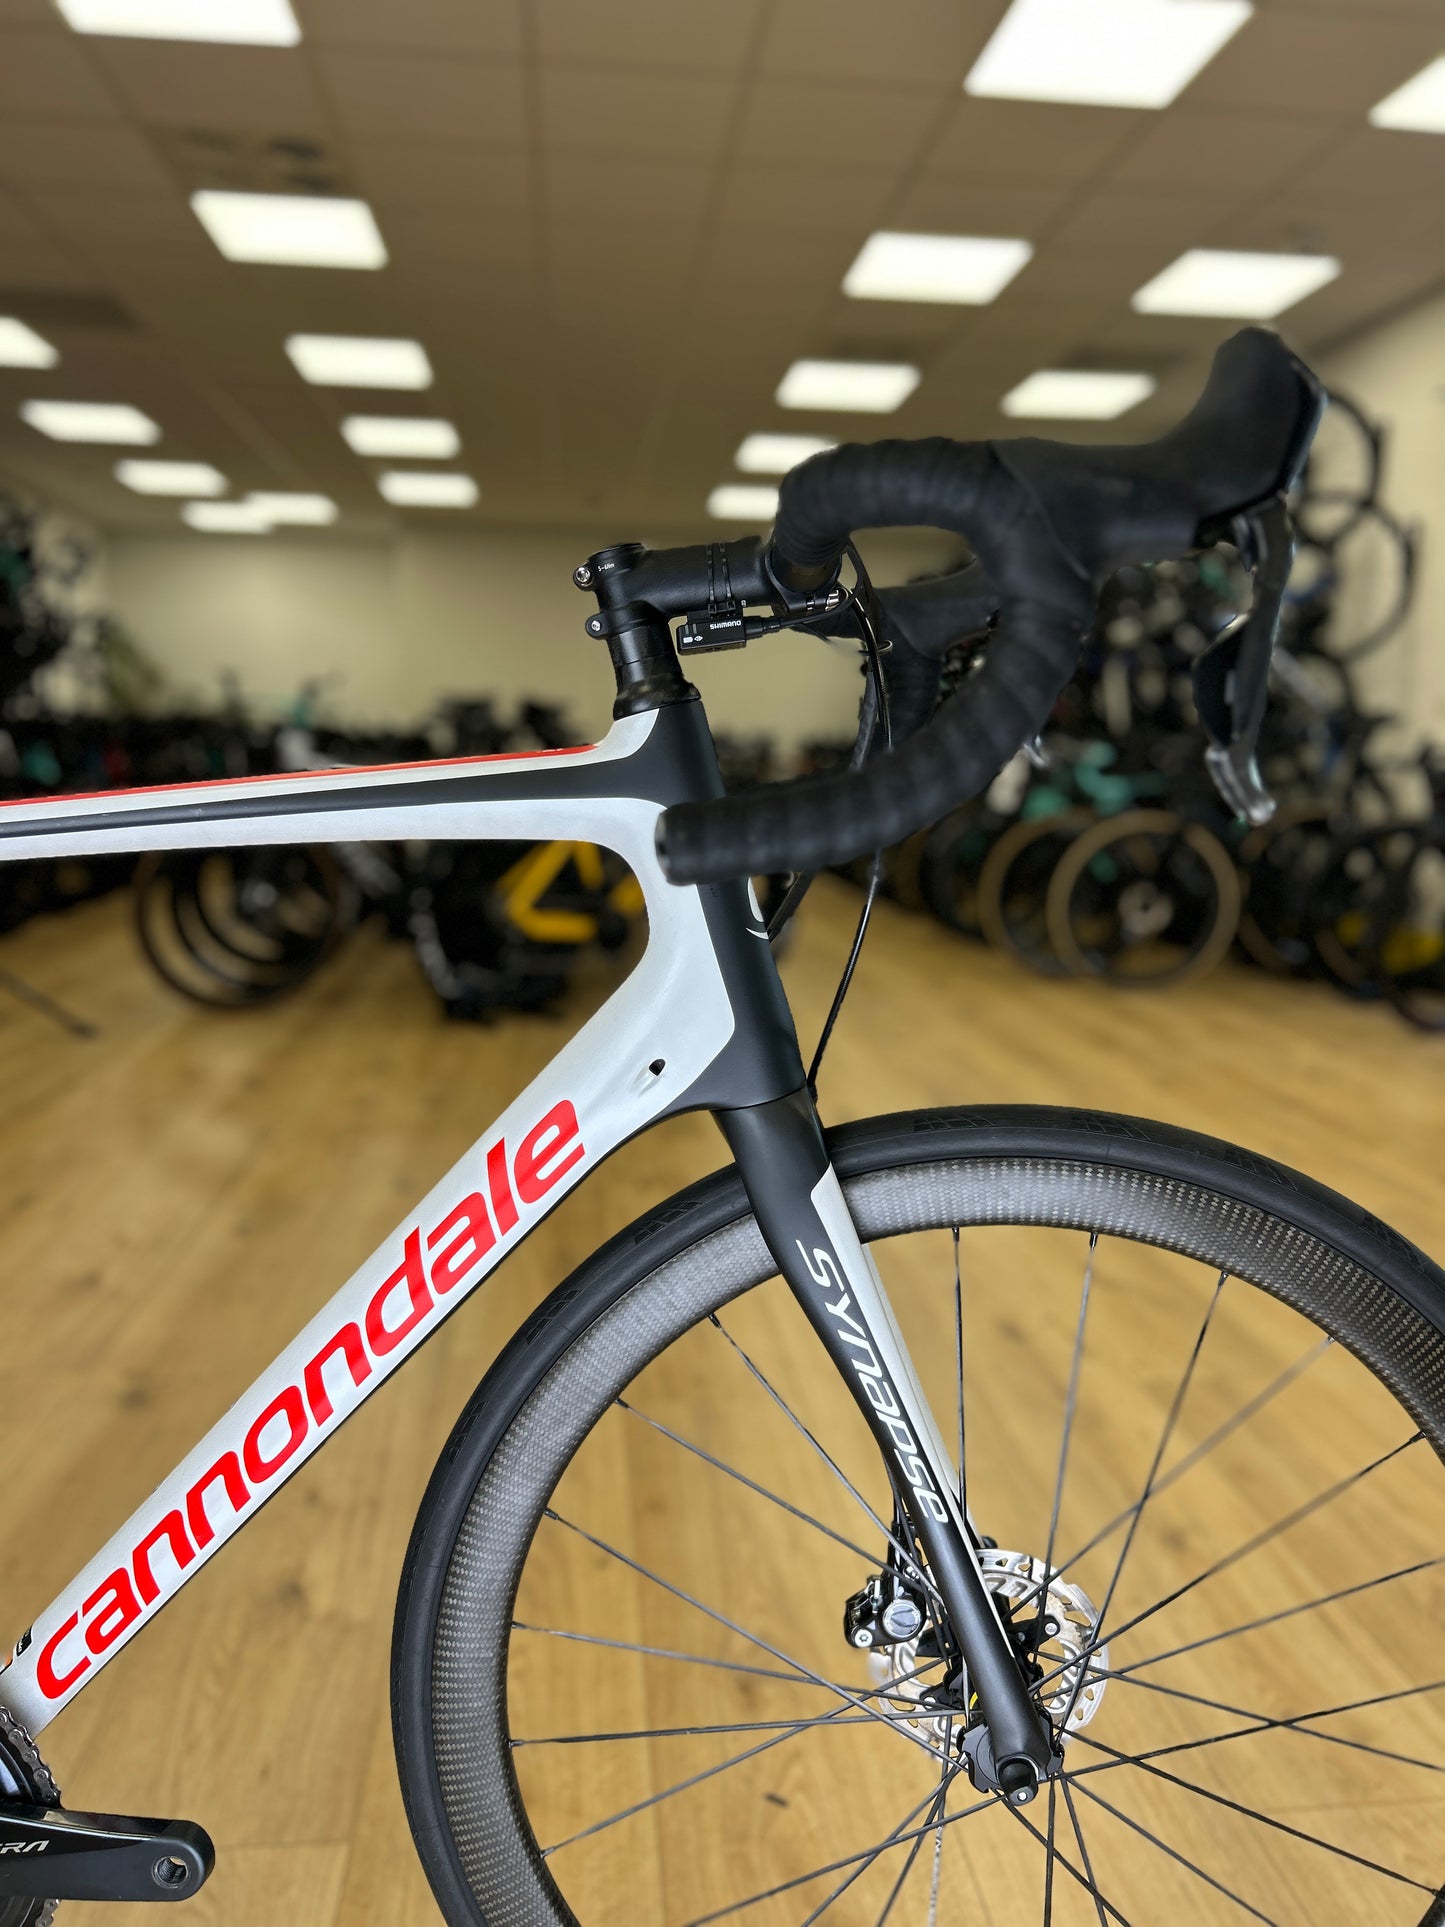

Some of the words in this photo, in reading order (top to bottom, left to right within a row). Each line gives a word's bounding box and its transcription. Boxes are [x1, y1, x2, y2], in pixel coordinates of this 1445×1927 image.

[709, 619, 742, 630] SHIMANO
[36, 1099, 586, 1700] cannondale
[0, 1839, 50, 1854] RA
